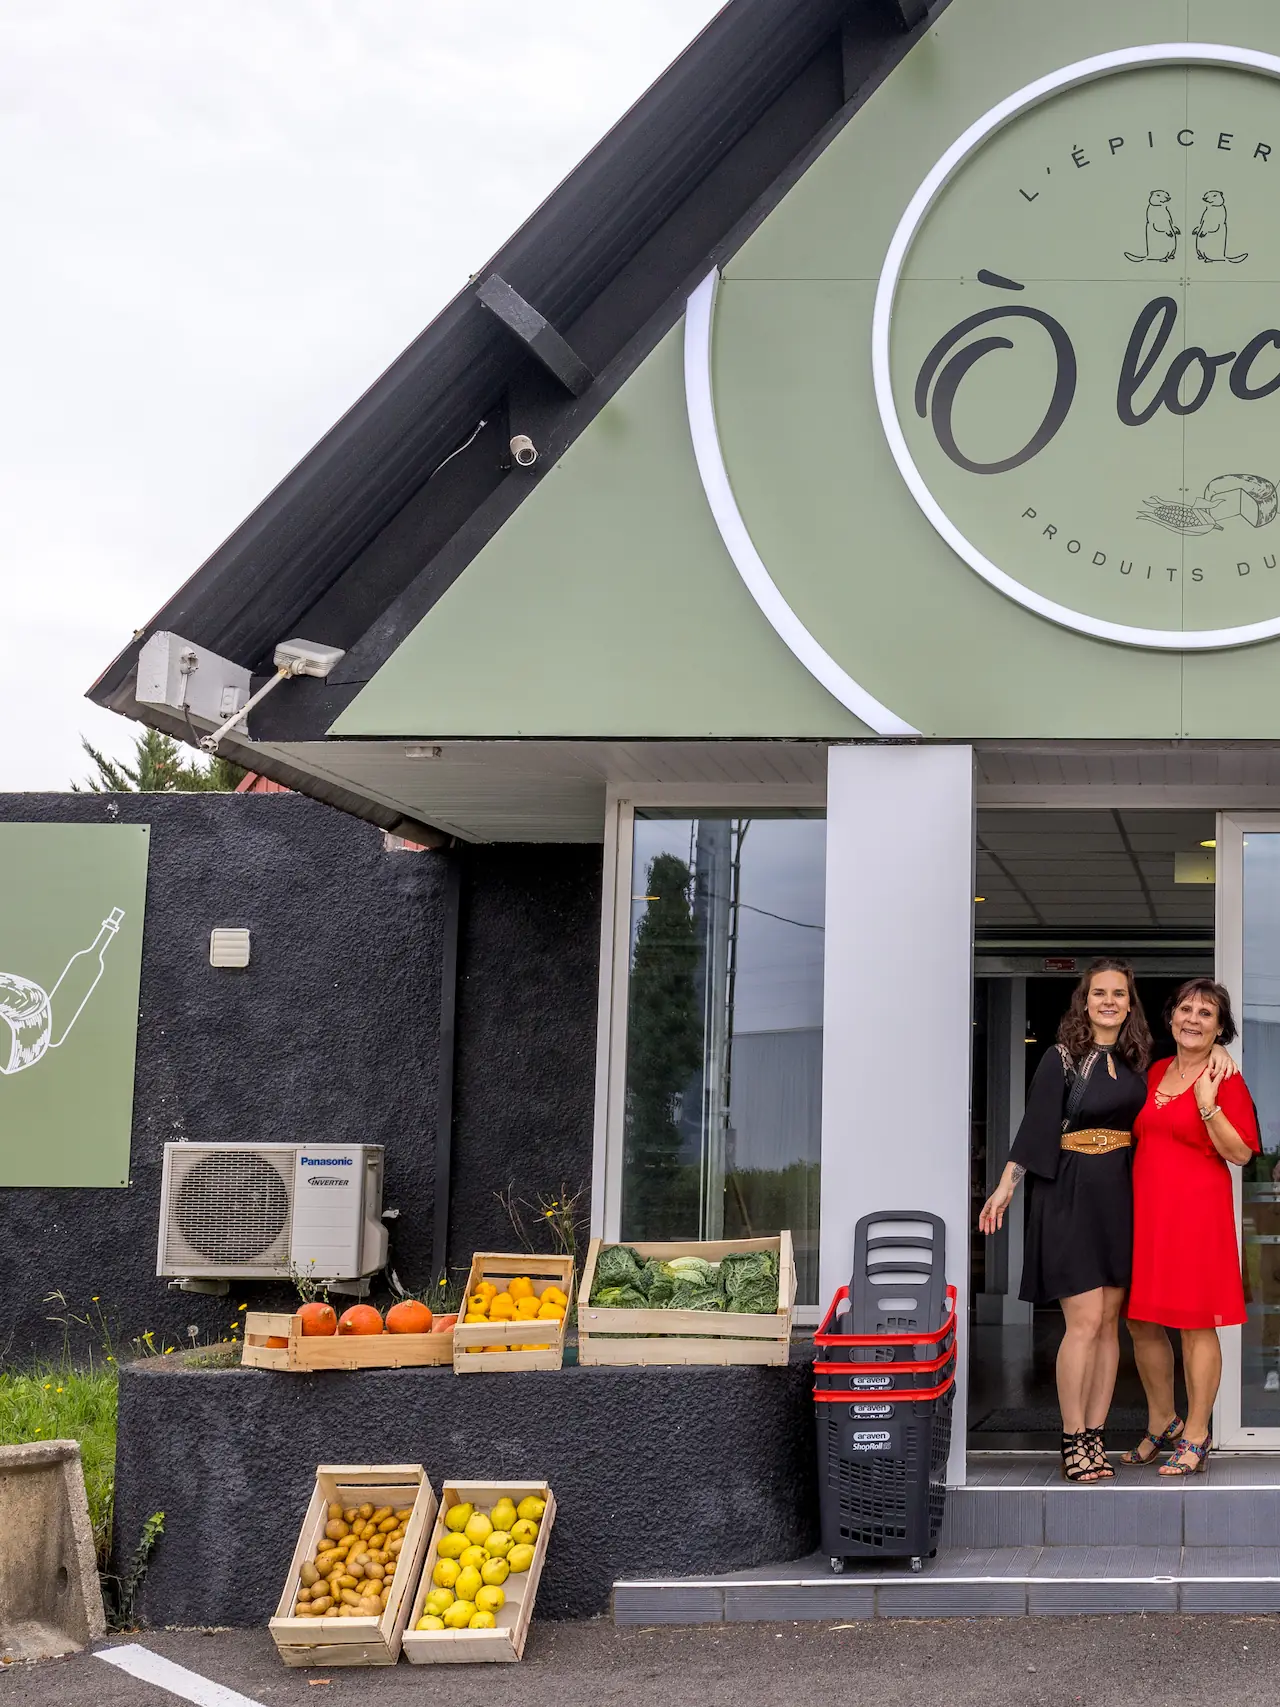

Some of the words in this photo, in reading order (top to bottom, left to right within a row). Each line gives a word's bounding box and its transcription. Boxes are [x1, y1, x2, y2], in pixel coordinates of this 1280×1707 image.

[1021, 507, 1204, 582] PRODUITS
[1237, 554, 1277, 577] DU
[301, 1156, 353, 1166] Panasonic
[852, 1442, 883, 1452] ShopRoll
